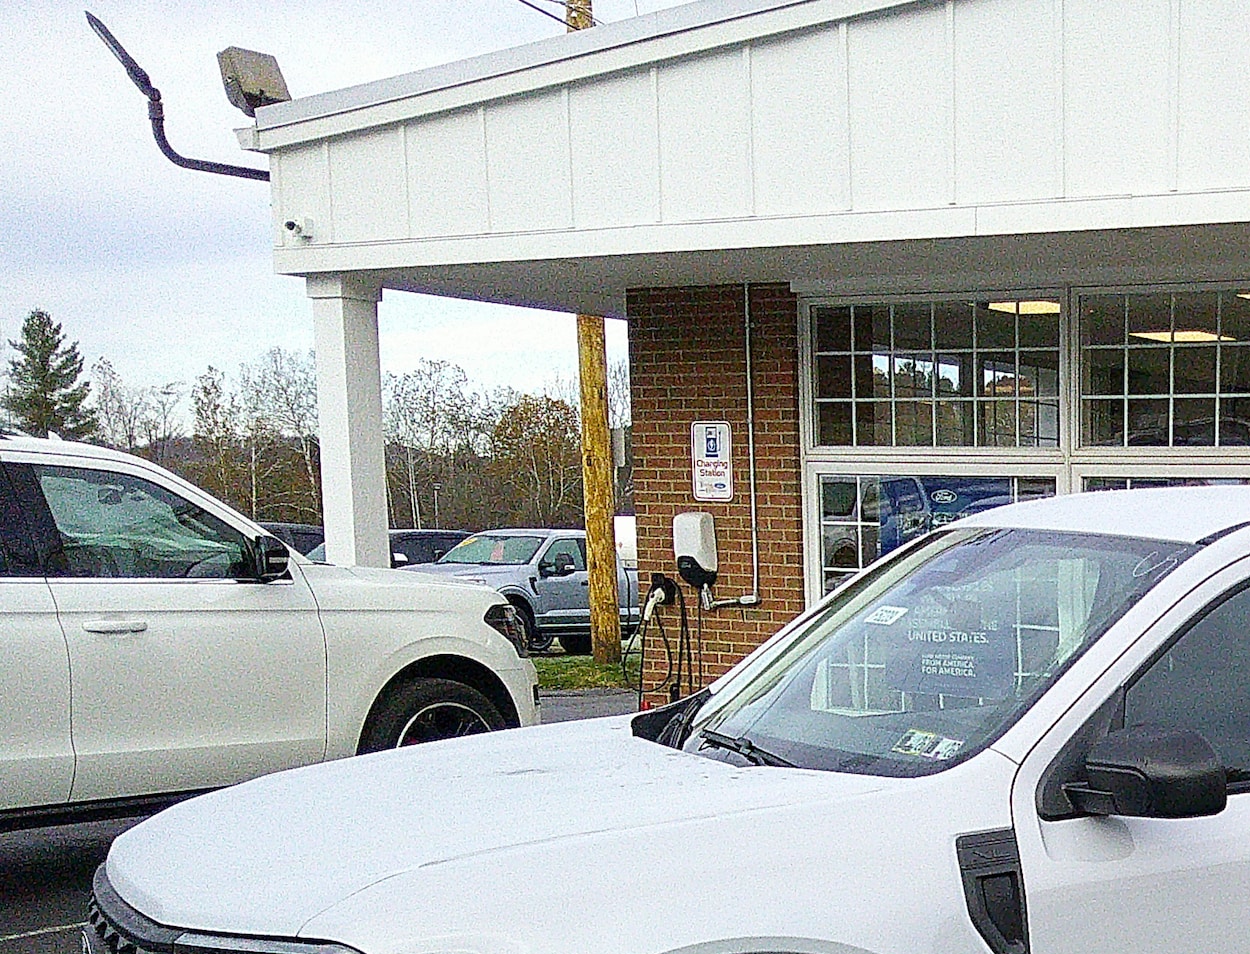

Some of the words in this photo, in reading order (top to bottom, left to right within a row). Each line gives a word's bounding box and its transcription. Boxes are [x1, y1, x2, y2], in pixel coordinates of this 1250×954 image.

[697, 460, 728, 469] Charging
[700, 469, 725, 477] Station
[908, 630, 946, 642] UNITED
[939, 667, 976, 677] AMERICA.
